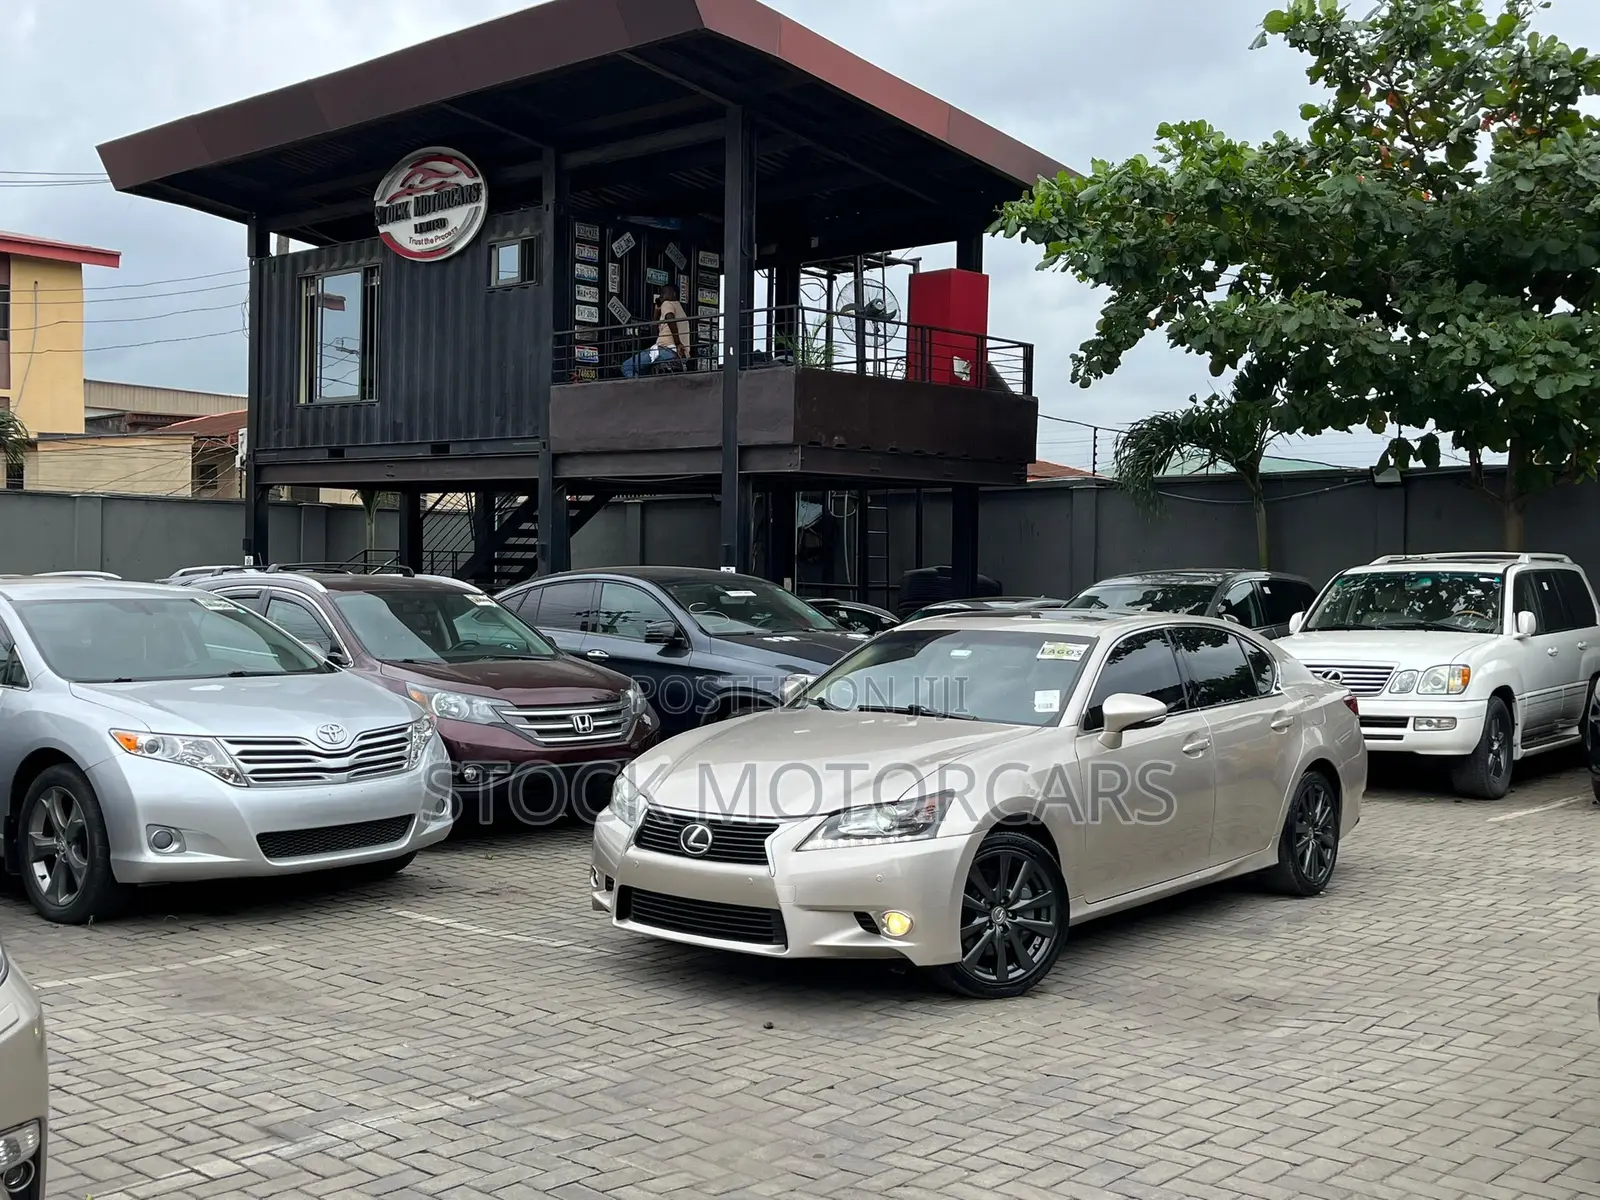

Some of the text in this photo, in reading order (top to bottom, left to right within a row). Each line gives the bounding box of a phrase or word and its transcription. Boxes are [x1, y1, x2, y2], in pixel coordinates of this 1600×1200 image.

[413, 183, 482, 217] MOTORCARS
[408, 226, 460, 246] Trust the Process
